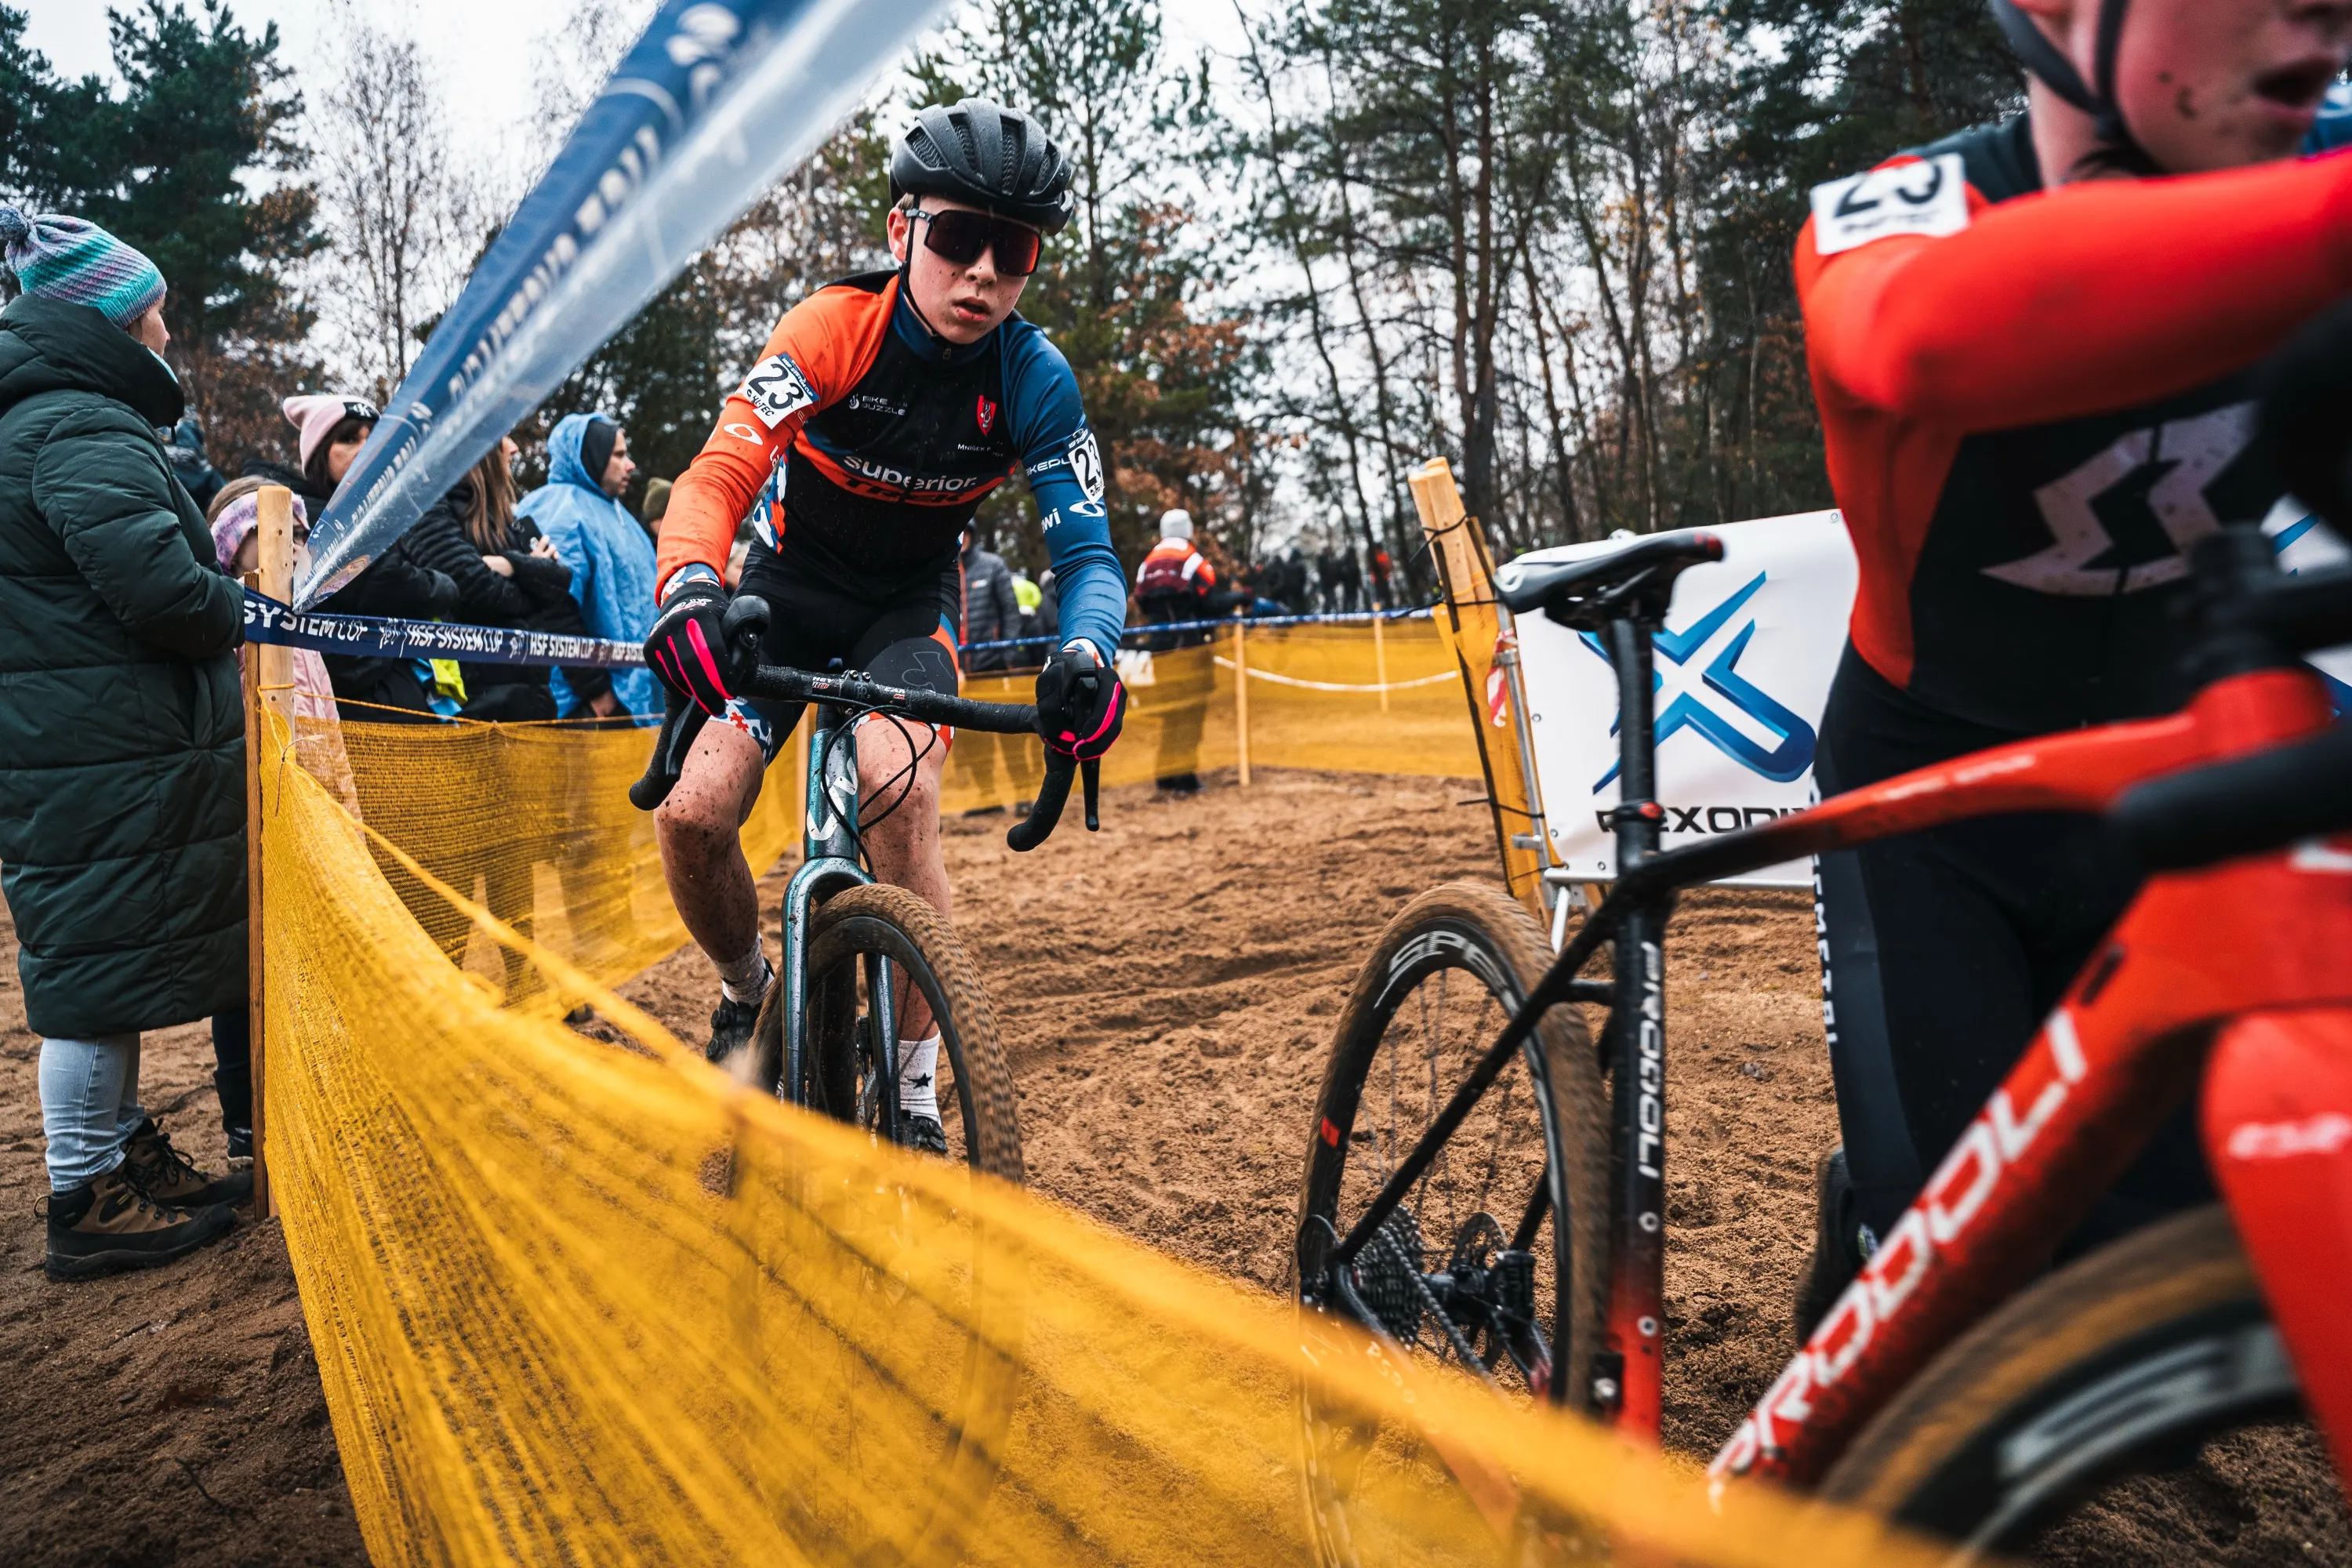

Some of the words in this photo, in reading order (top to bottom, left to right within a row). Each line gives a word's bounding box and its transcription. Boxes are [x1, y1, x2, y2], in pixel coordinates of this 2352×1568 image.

[749, 364, 804, 409] 23
[862, 395, 888, 405] BIKE
[862, 403, 906, 416] PUZZLE
[844, 456, 978, 491] superior
[407, 624, 436, 648] HSF
[436, 625, 485, 652] SYSTEM
[483, 628, 503, 653] CUP
[529, 633, 549, 656] HSF
[548, 634, 581, 659] SYSTEM
